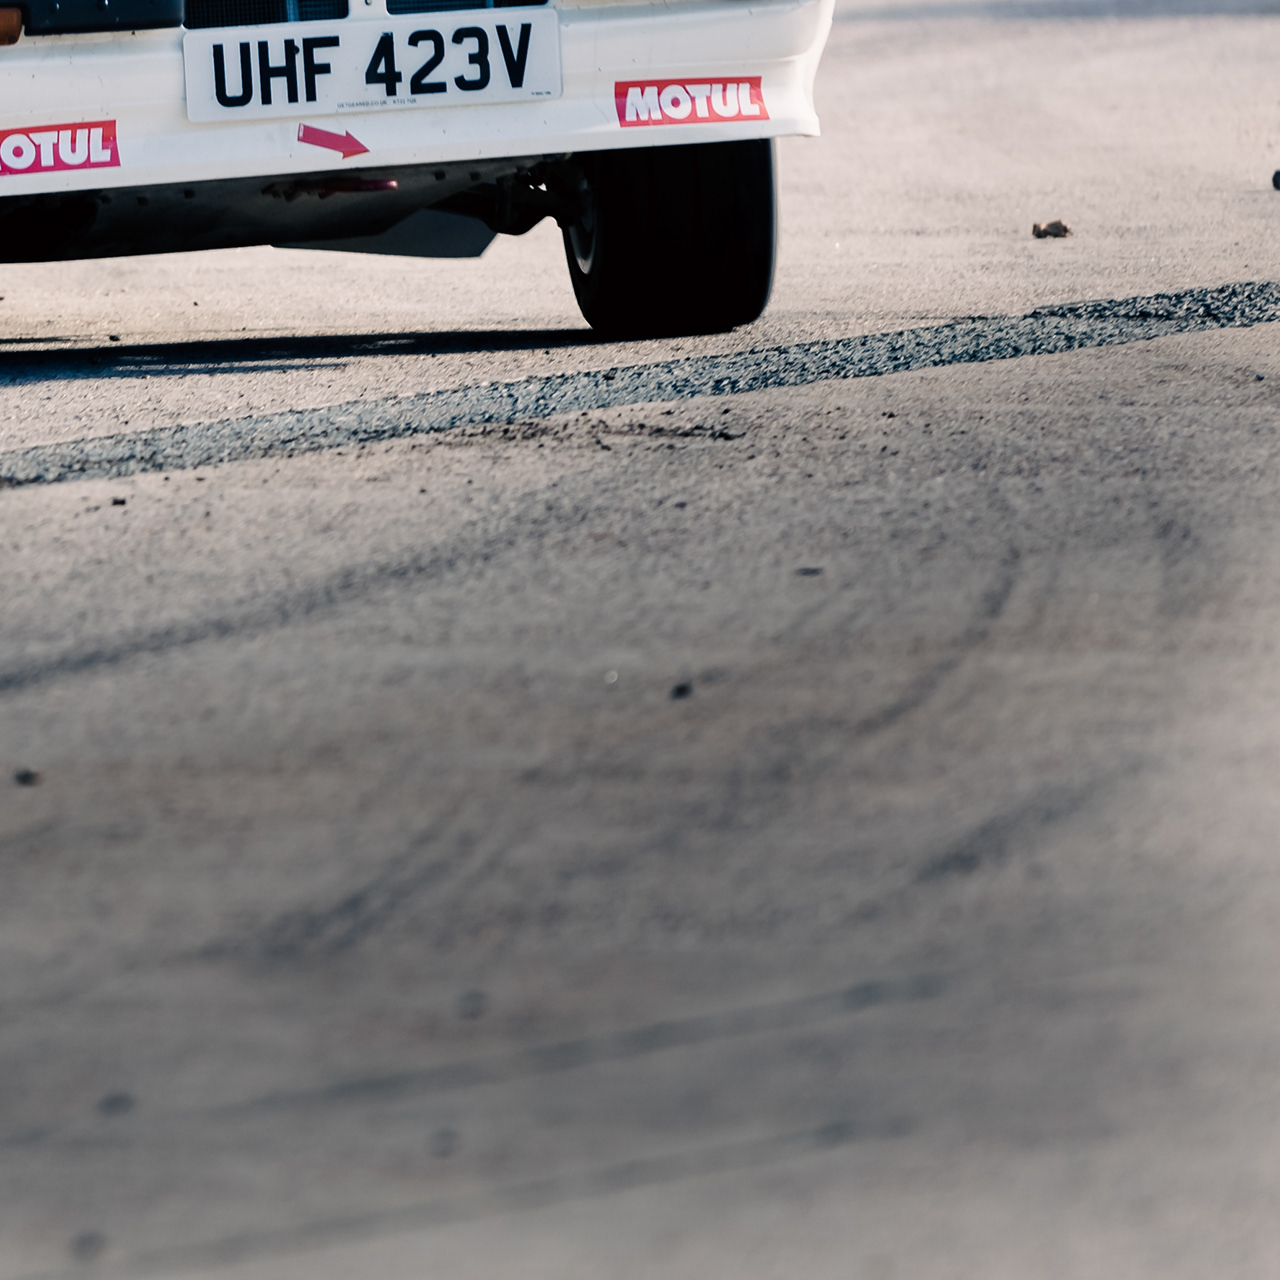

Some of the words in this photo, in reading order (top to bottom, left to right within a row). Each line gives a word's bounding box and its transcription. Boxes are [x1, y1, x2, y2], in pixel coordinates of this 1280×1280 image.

[212, 36, 340, 107] UHF
[365, 23, 532, 96] 423V
[625, 82, 761, 122] MOTUL
